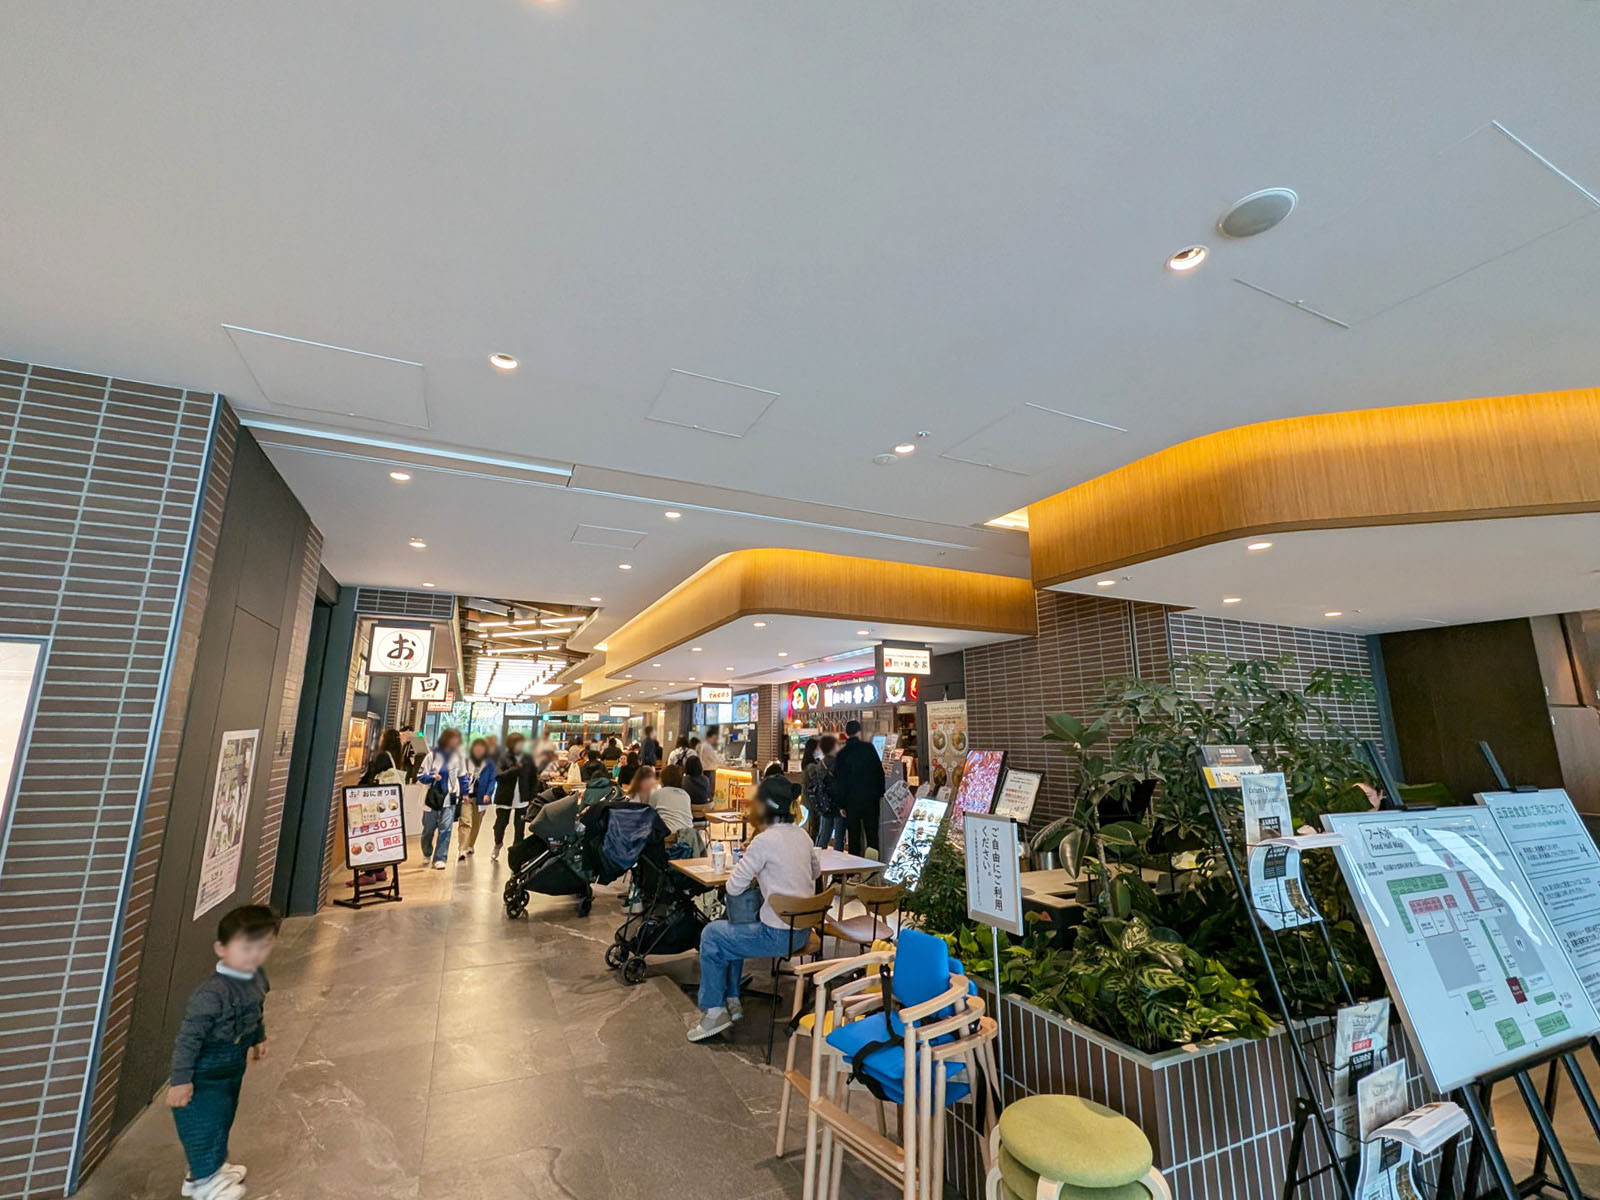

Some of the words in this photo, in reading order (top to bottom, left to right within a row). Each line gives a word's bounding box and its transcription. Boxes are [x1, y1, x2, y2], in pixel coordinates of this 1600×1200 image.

[387, 633, 416, 660] お
[420, 678, 439, 692] 回
[363, 788, 397, 797] おにぎり屋
[992, 827, 1003, 911] ご自由にご利用
